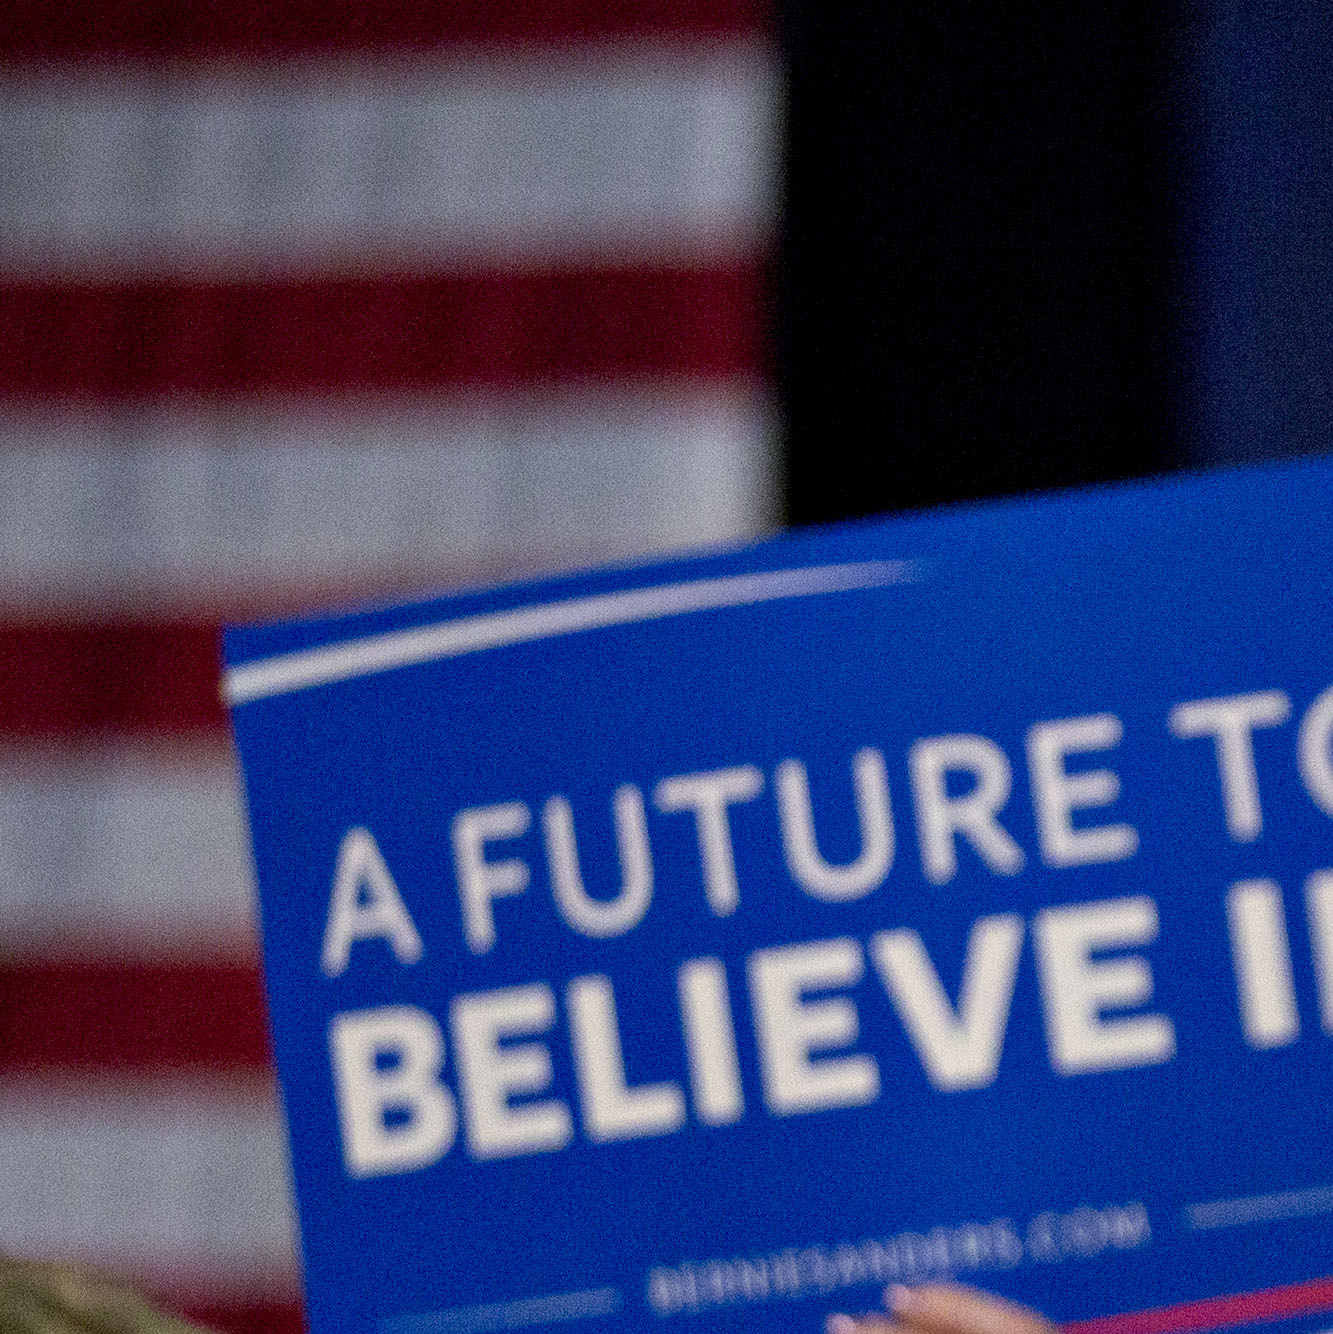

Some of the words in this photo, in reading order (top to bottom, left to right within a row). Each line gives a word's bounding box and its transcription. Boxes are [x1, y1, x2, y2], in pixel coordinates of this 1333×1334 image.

[321, 828, 423, 976] A
[452, 712, 1139, 951] FUTURE
[330, 896, 1176, 1178] BELIEVE
[647, 1200, 1151, 1316] BERNIESANDERS.COM
